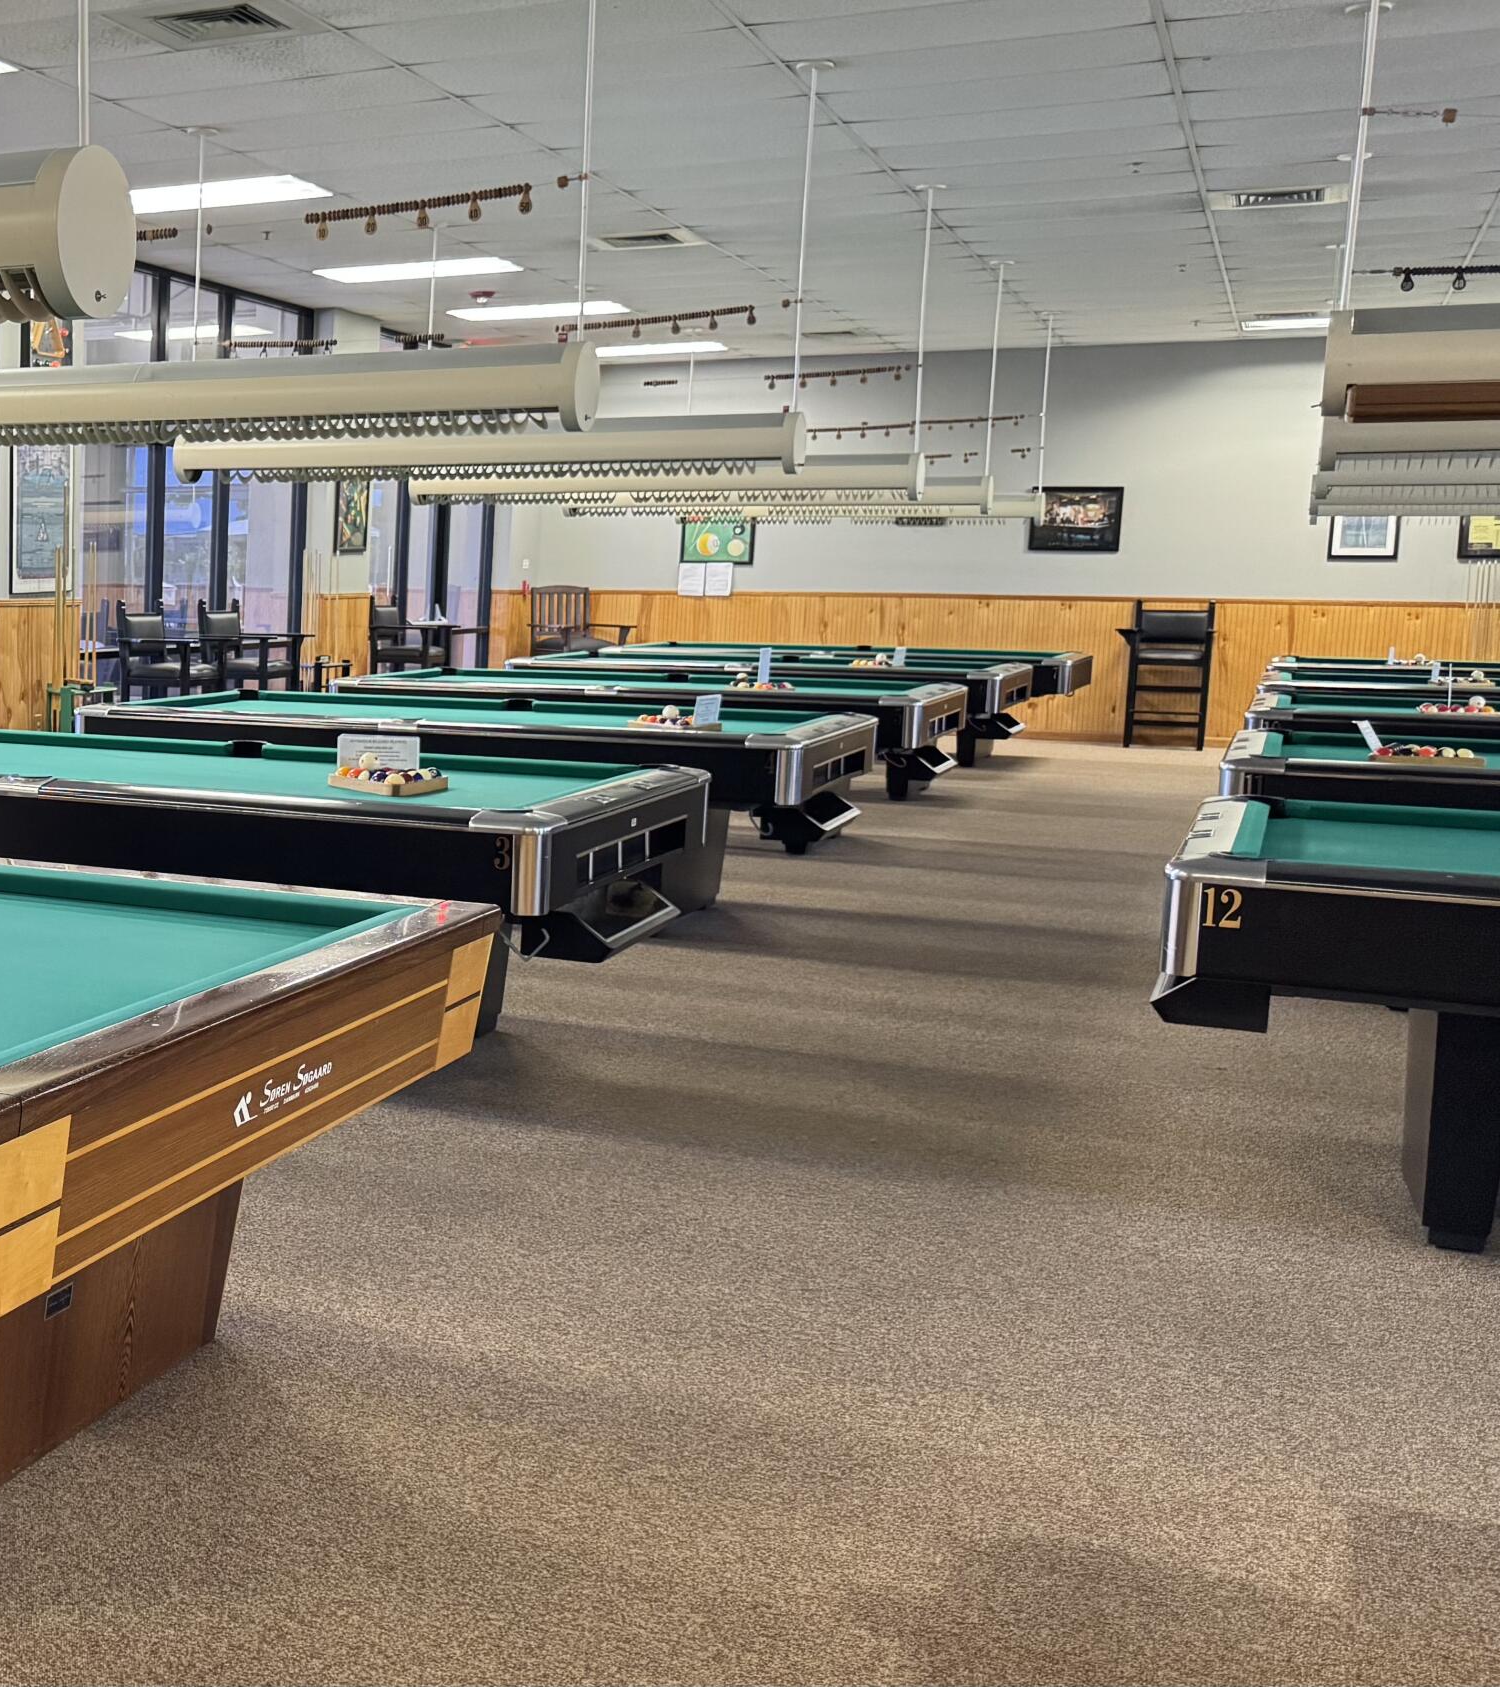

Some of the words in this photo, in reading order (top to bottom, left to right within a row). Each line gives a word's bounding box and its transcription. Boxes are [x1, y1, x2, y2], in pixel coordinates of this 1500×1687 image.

[519, 202, 530, 211] 50
[366, 222, 375, 233] 20
[318, 229, 326, 239] 10
[493, 836, 511, 870] 3
[1202, 887, 1243, 929] 12
